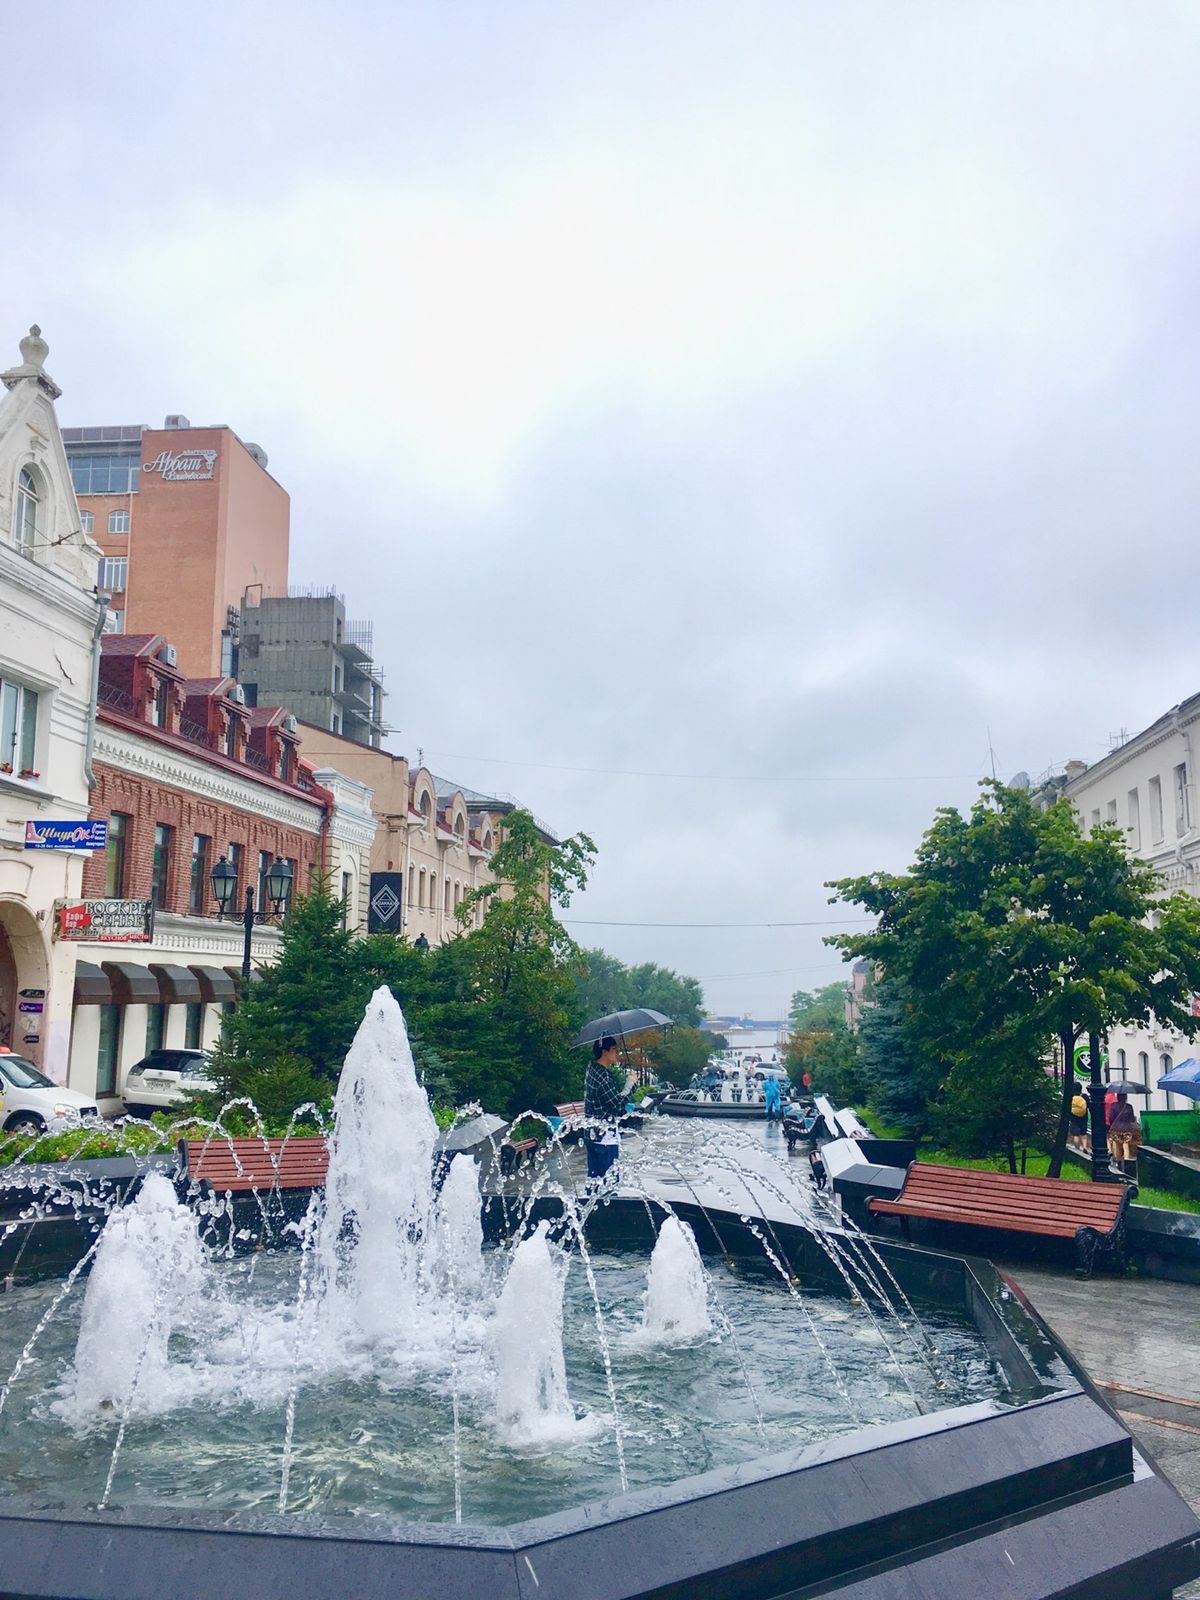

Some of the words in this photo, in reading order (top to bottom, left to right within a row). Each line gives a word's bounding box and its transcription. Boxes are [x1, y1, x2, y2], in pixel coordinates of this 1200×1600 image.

[142, 450, 202, 479] Арбат
[84, 902, 147, 916] ВОСКРЕ
[91, 914, 143, 928] СЕНЬЕ
